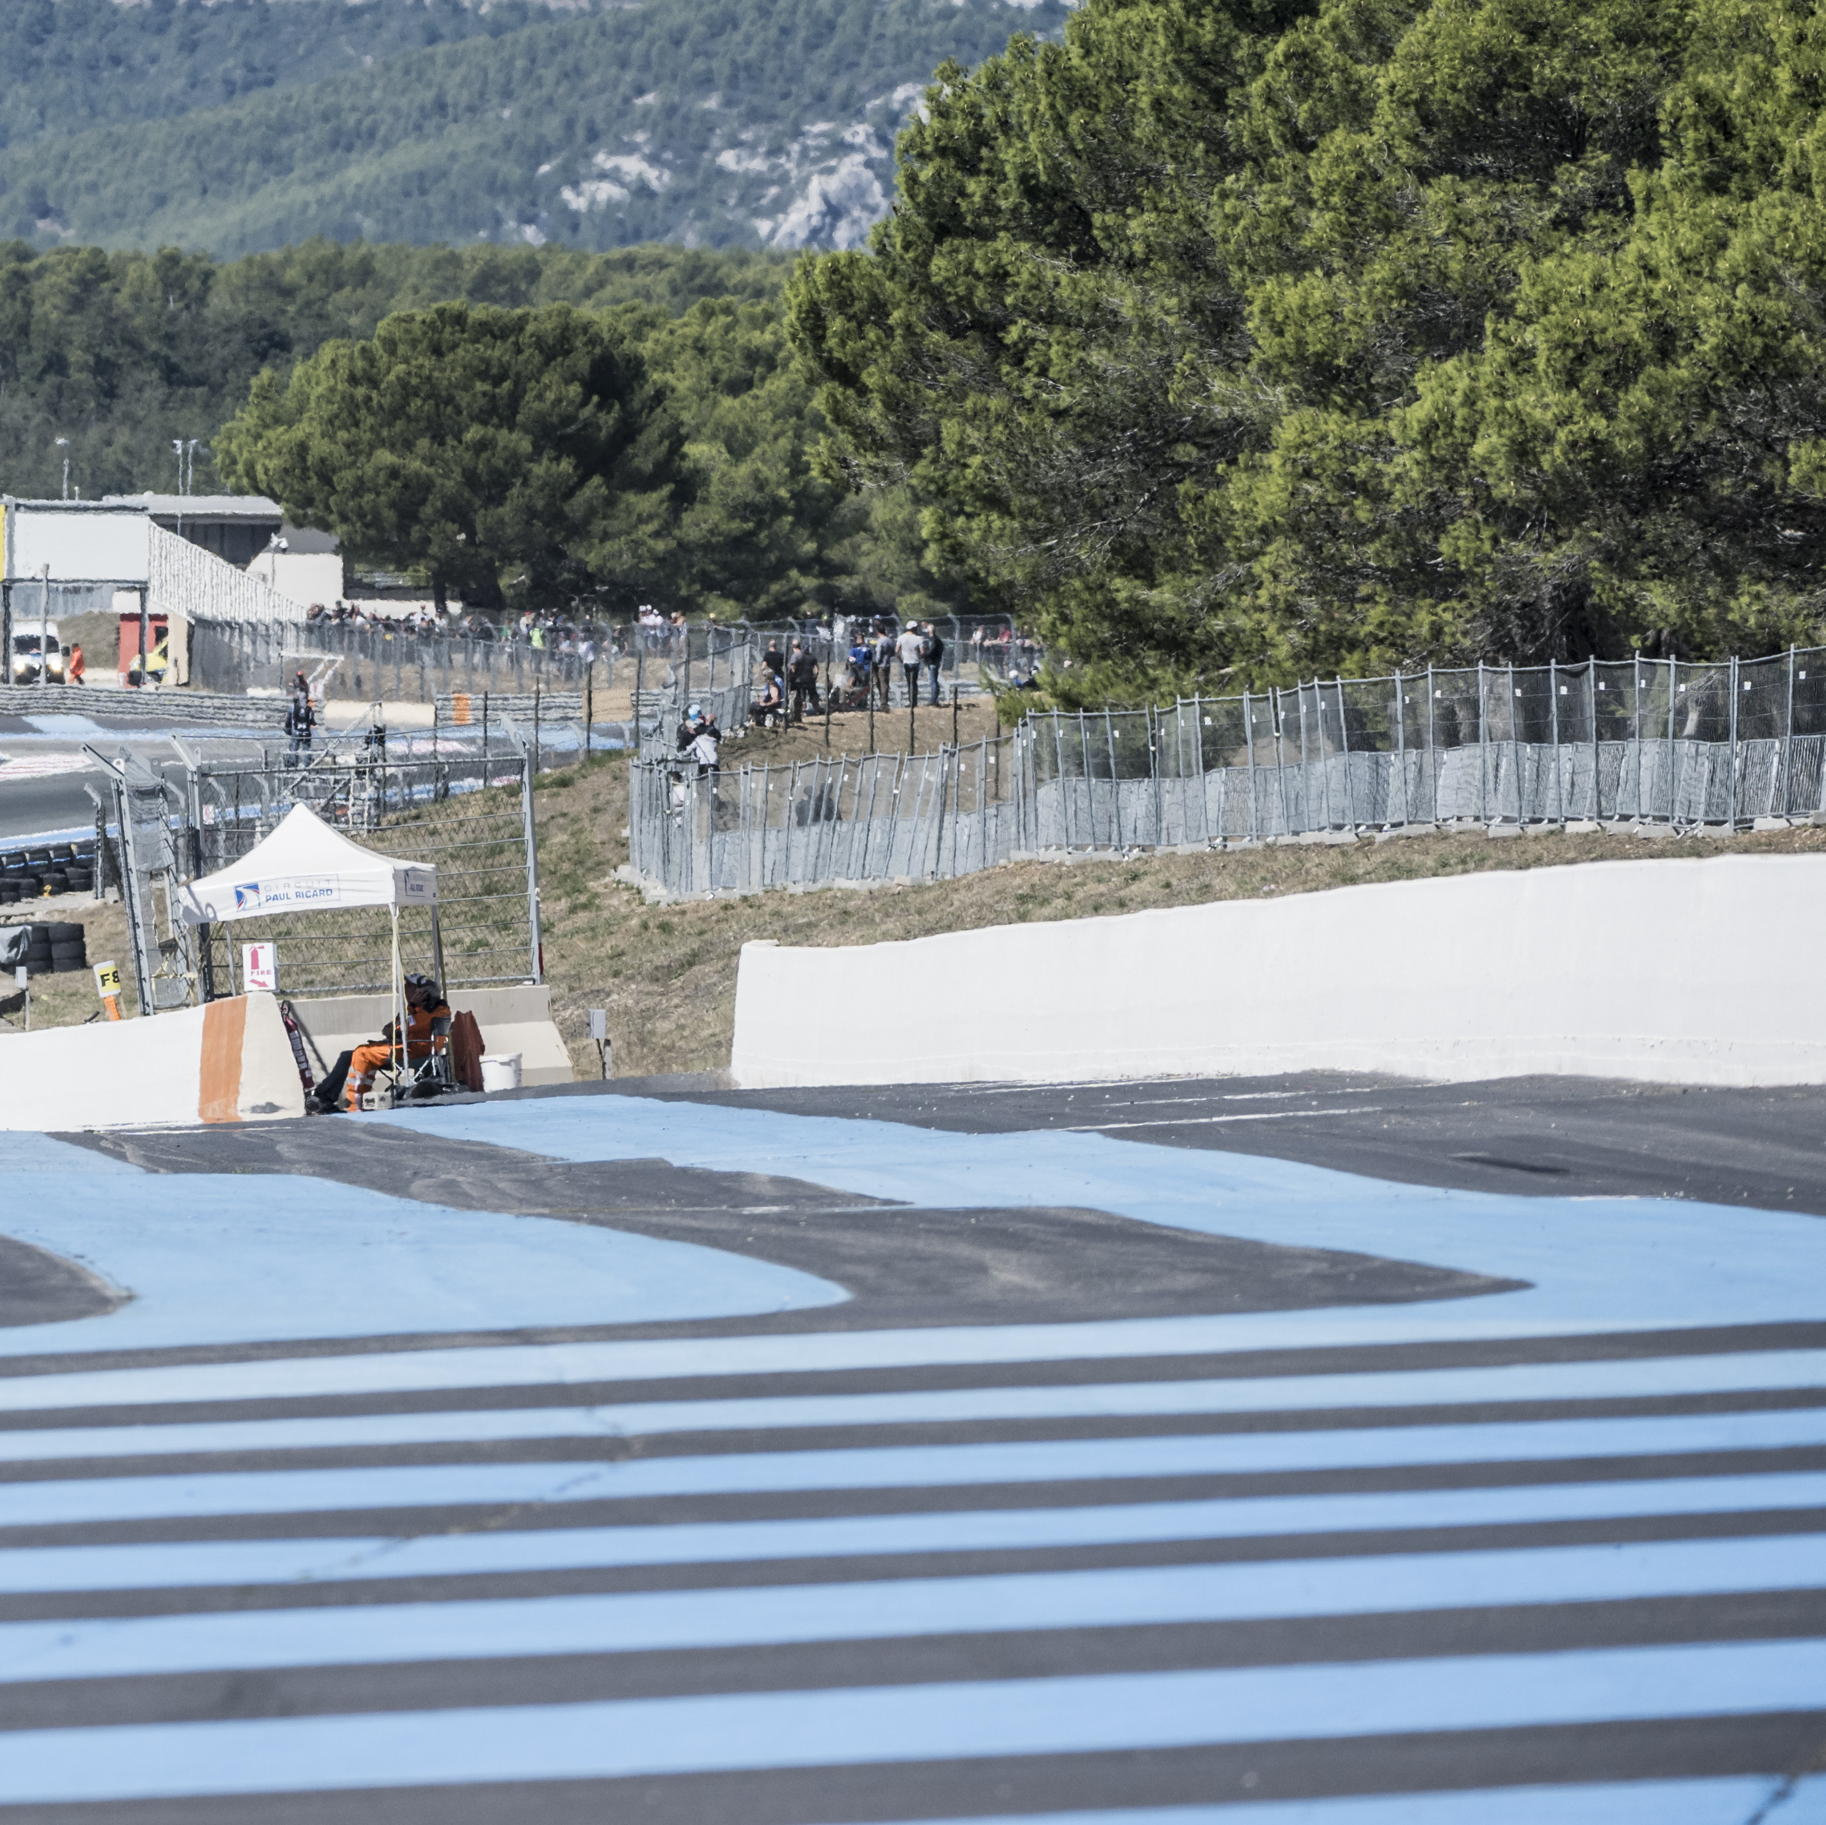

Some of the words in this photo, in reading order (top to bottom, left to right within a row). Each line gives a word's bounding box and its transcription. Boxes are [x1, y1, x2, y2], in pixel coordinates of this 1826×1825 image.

[264, 879, 332, 892] CIRCUIT
[265, 892, 291, 902] PAUL
[295, 889, 333, 899] RICARD
[100, 970, 120, 987] F8
